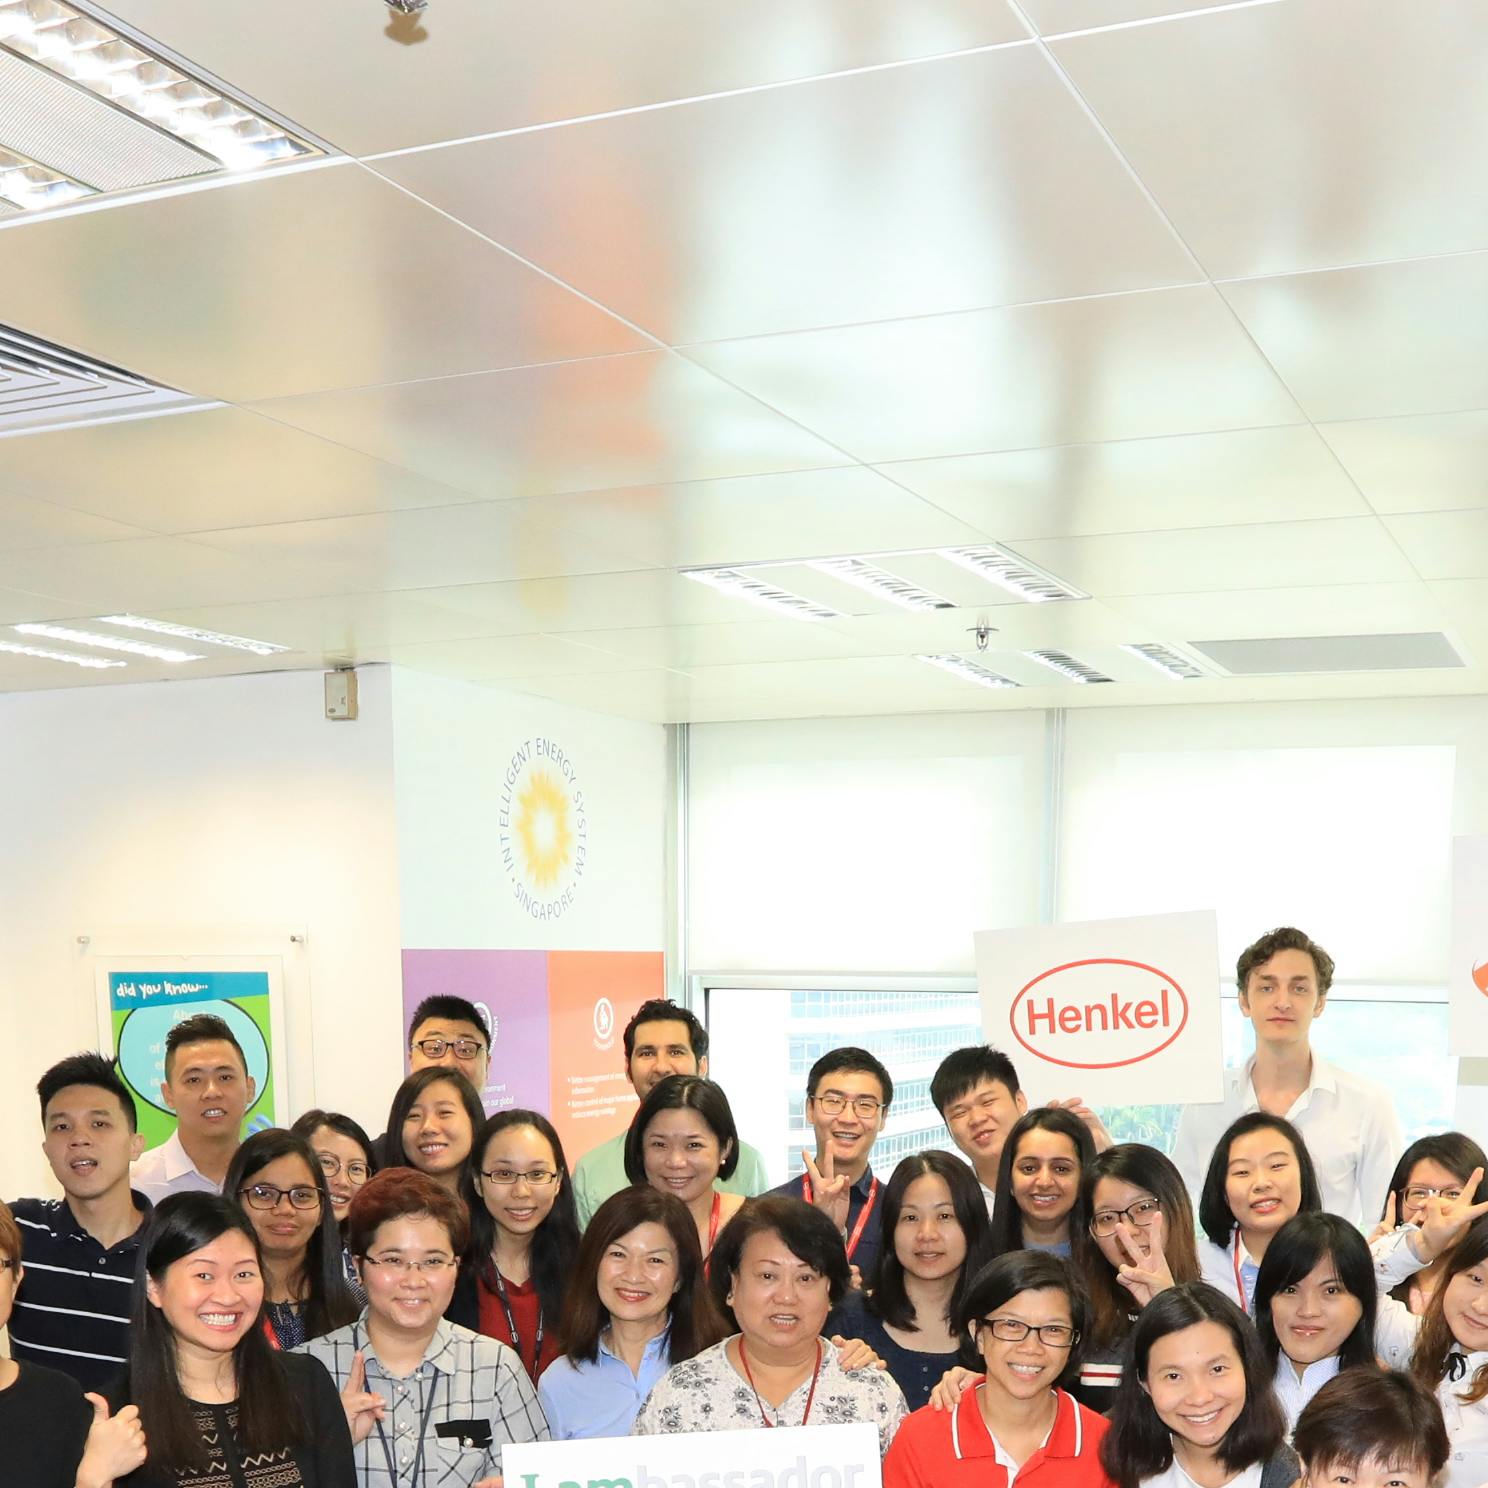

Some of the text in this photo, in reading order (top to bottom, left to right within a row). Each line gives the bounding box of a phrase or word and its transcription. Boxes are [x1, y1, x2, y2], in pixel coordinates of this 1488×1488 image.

[499, 737, 587, 877] INTELLIGENT ENERGY SYSTEM
[514, 882, 574, 920] SINGAPORE
[117, 982, 136, 997] did
[139, 983, 161, 999] you
[1027, 989, 1170, 1036] Henkel
